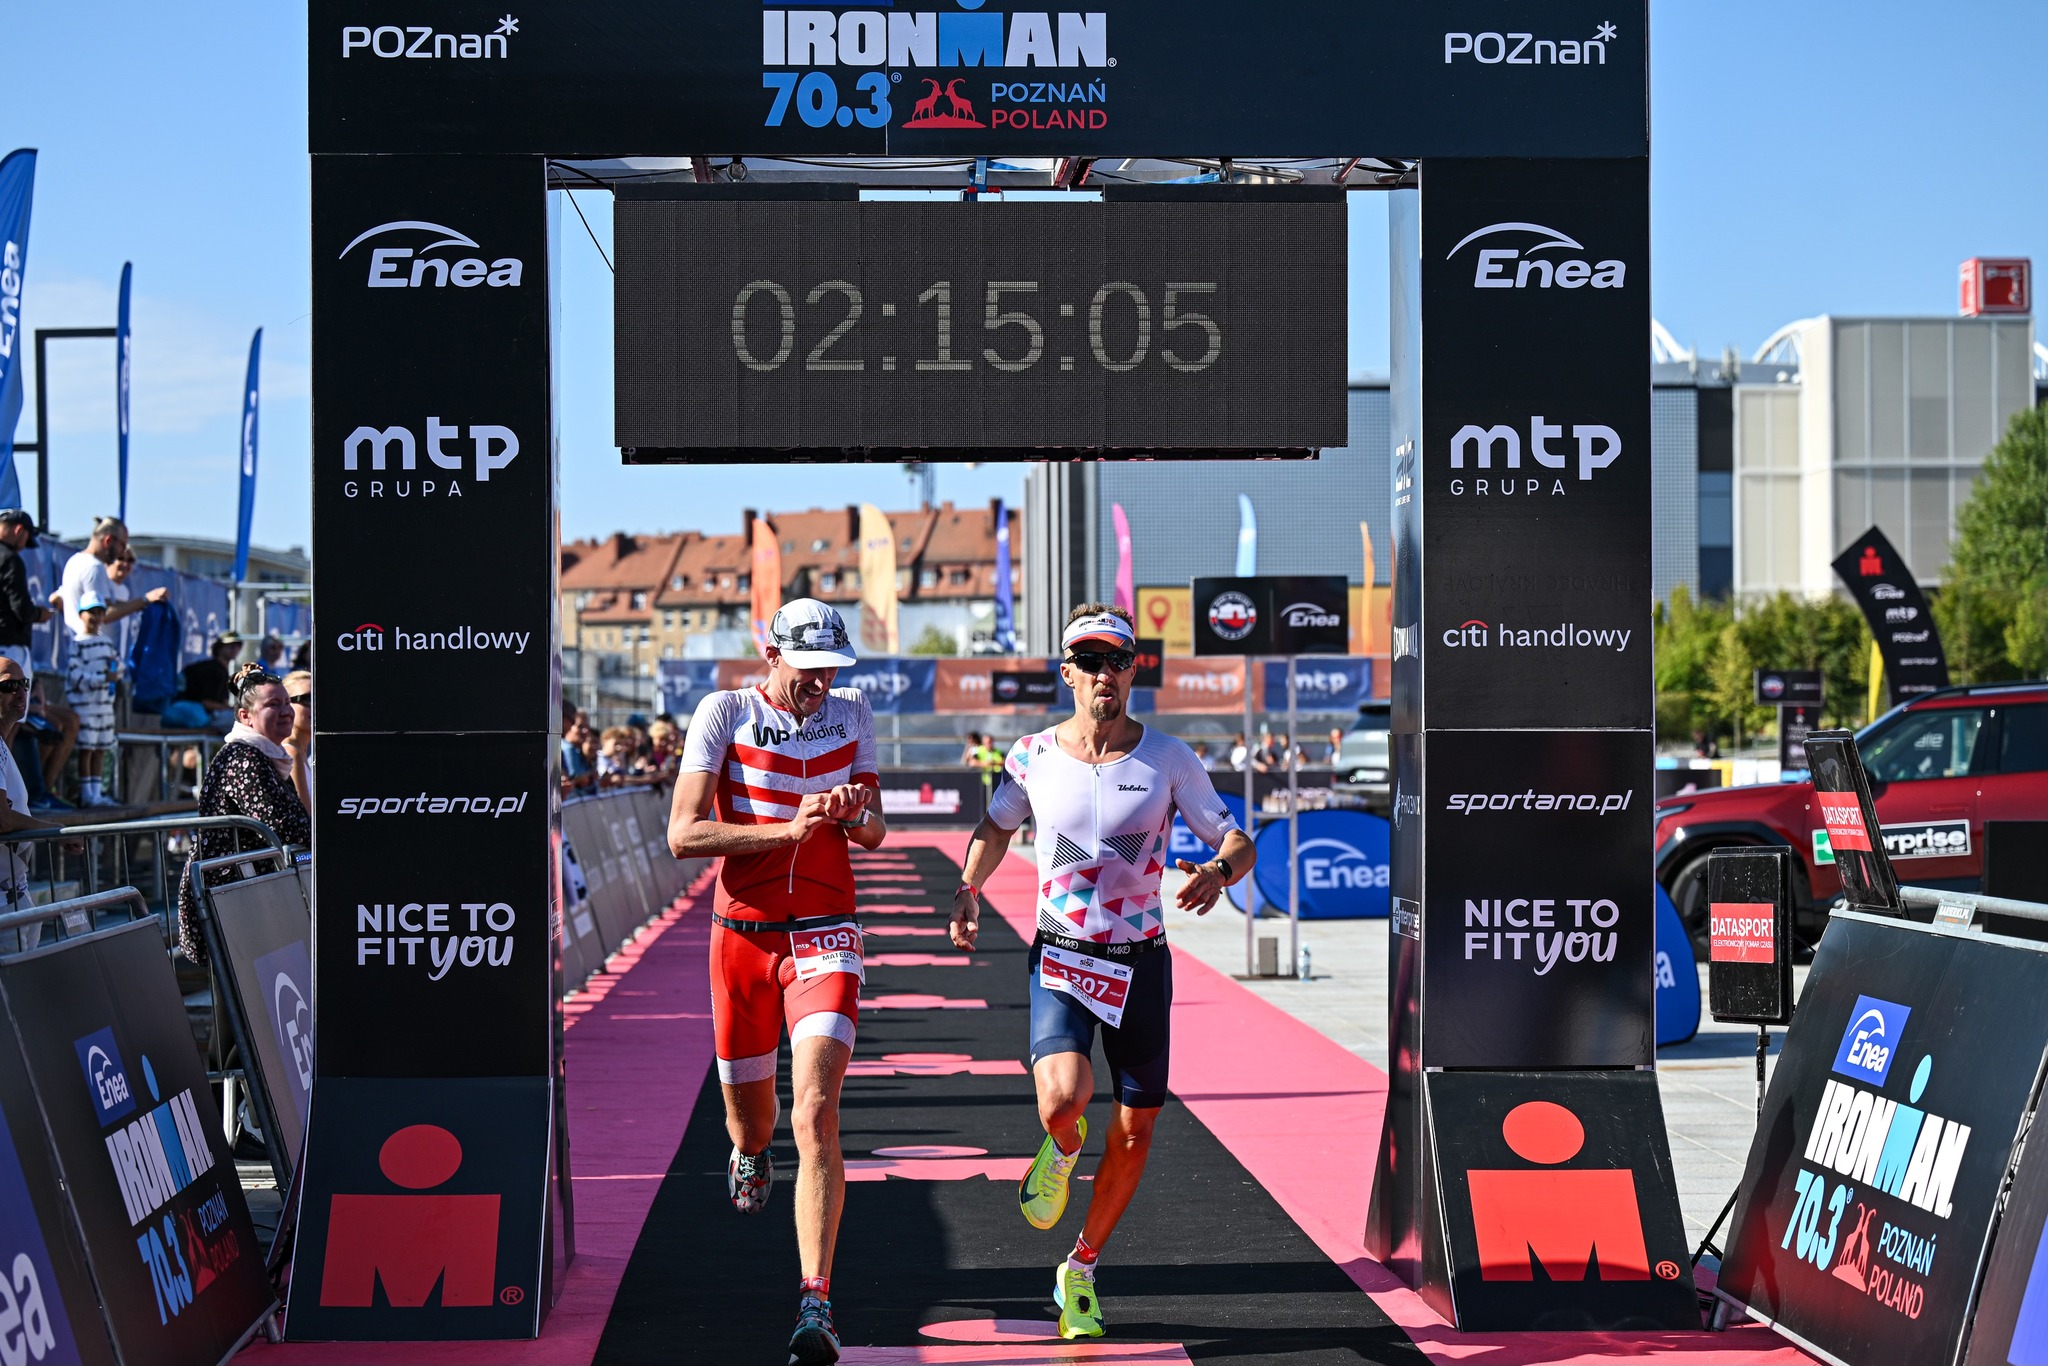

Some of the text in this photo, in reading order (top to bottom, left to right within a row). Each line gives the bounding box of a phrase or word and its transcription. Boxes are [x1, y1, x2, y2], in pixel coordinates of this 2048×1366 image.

[763, 11, 1107, 67] IRONMAN
[763, 72, 892, 128] 70.3
[991, 78, 1106, 102] POZNAŃ
[991, 110, 1107, 129] POLAND
[368, 248, 523, 288] Enea
[1474, 249, 1626, 289] Enea
[732, 279, 1223, 372] 02:15:05
[344, 417, 519, 481] mtp
[1451, 416, 1622, 480] mtp
[344, 481, 463, 498] GRUPA
[1451, 479, 1566, 496] GRUPA
[1289, 611, 1341, 627] Enea
[337, 625, 530, 655] citi handlowy
[1443, 622, 1632, 652] citi handlowy
[850, 669, 911, 696] mtp
[1178, 670, 1241, 695] mtp
[796, 723, 847, 741] Holding
[337, 791, 528, 819] sportano.pl
[1446, 789, 1633, 816] sportano.pl
[1822, 806, 1862, 826] DATASPORT
[357, 903, 515, 932] NICE TO
[1465, 899, 1619, 927] NICE TO
[1711, 918, 1773, 937] DATASPORT
[811, 932, 857, 952] 1097
[822, 951, 856, 961] MATEUSZ
[1055, 936, 1079, 950] MAKO
[1106, 945, 1131, 955] MAKO
[1465, 932, 1531, 960] FIT
[1533, 931, 1618, 976] you
[357, 936, 515, 981] FIT you
[1059, 968, 1109, 998] 1207
[1847, 1030, 1889, 1073] Enea
[95, 1070, 129, 1110] Enea
[105, 1088, 214, 1227] IRONMAN
[1804, 1079, 1972, 1218] IRONMAN
[198, 1184, 229, 1237] POZNAŃ
[1781, 1168, 1846, 1271] 70.3
[209, 1230, 239, 1278] POLAND
[1878, 1222, 1936, 1277] POZNAŃ
[136, 1214, 193, 1326] 70.3
[1867, 1265, 1924, 1320] POLAND
